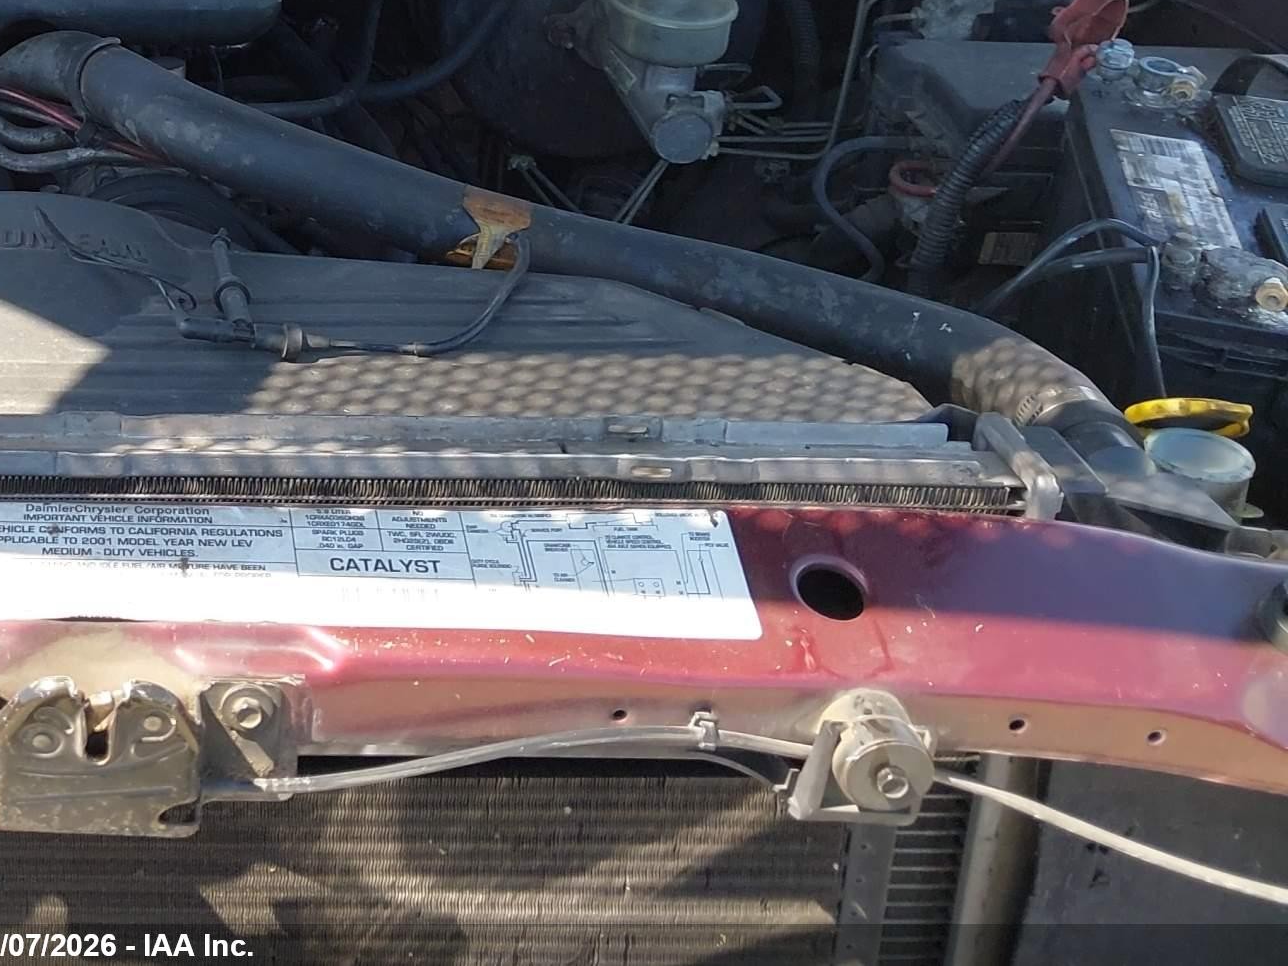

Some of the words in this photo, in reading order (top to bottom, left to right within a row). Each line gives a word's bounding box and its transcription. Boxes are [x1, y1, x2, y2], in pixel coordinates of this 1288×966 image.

[26, 503, 127, 515] DaimlerChrysler
[134, 505, 210, 516] Corporation
[23, 514, 86, 522] IMPORTANT
[137, 515, 213, 524] INFORMATION
[111, 526, 125, 535] TO
[128, 526, 197, 536] CALIFORNIA
[201, 528, 283, 537] REGULATIONS
[63, 536, 78, 544] TO
[81, 537, 113, 545] 2001
[117, 538, 159, 546] MODEL
[163, 538, 194, 547] YEAR
[198, 539, 227, 547] NEW
[231, 539, 253, 548] LEV
[41, 547, 92, 556] MEDIUM
[103, 548, 135, 556] DUTY
[138, 549, 199, 558] VEHICLES.
[169, 563, 210, 571] MITURE
[213, 563, 239, 571] HAVE
[329, 557, 441, 574] CATALYST
